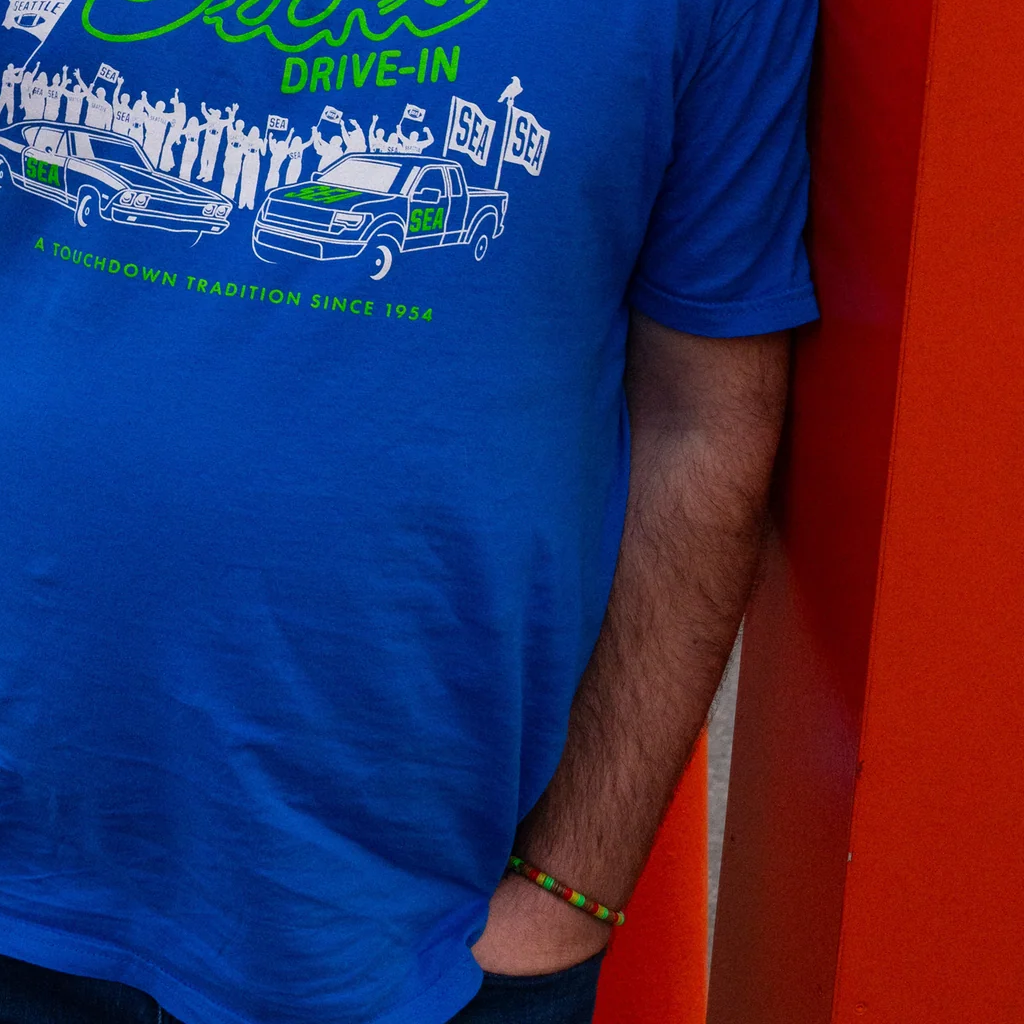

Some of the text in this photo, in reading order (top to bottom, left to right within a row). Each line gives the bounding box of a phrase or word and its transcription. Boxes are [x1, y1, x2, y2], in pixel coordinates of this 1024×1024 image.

[13, 0, 65, 15] SEATTLE
[99, 66, 117, 82] SEA
[280, 45, 461, 94] DRIVE-IN
[116, 110, 131, 123] SEA
[269, 117, 286, 130] SEA
[456, 105, 490, 161] SEA
[511, 115, 545, 171] SEA
[26, 157, 61, 187] SEA
[409, 207, 444, 233] SEA
[34, 237, 433, 322] A TOUCHDOWN TRADITION SINCE 1954
